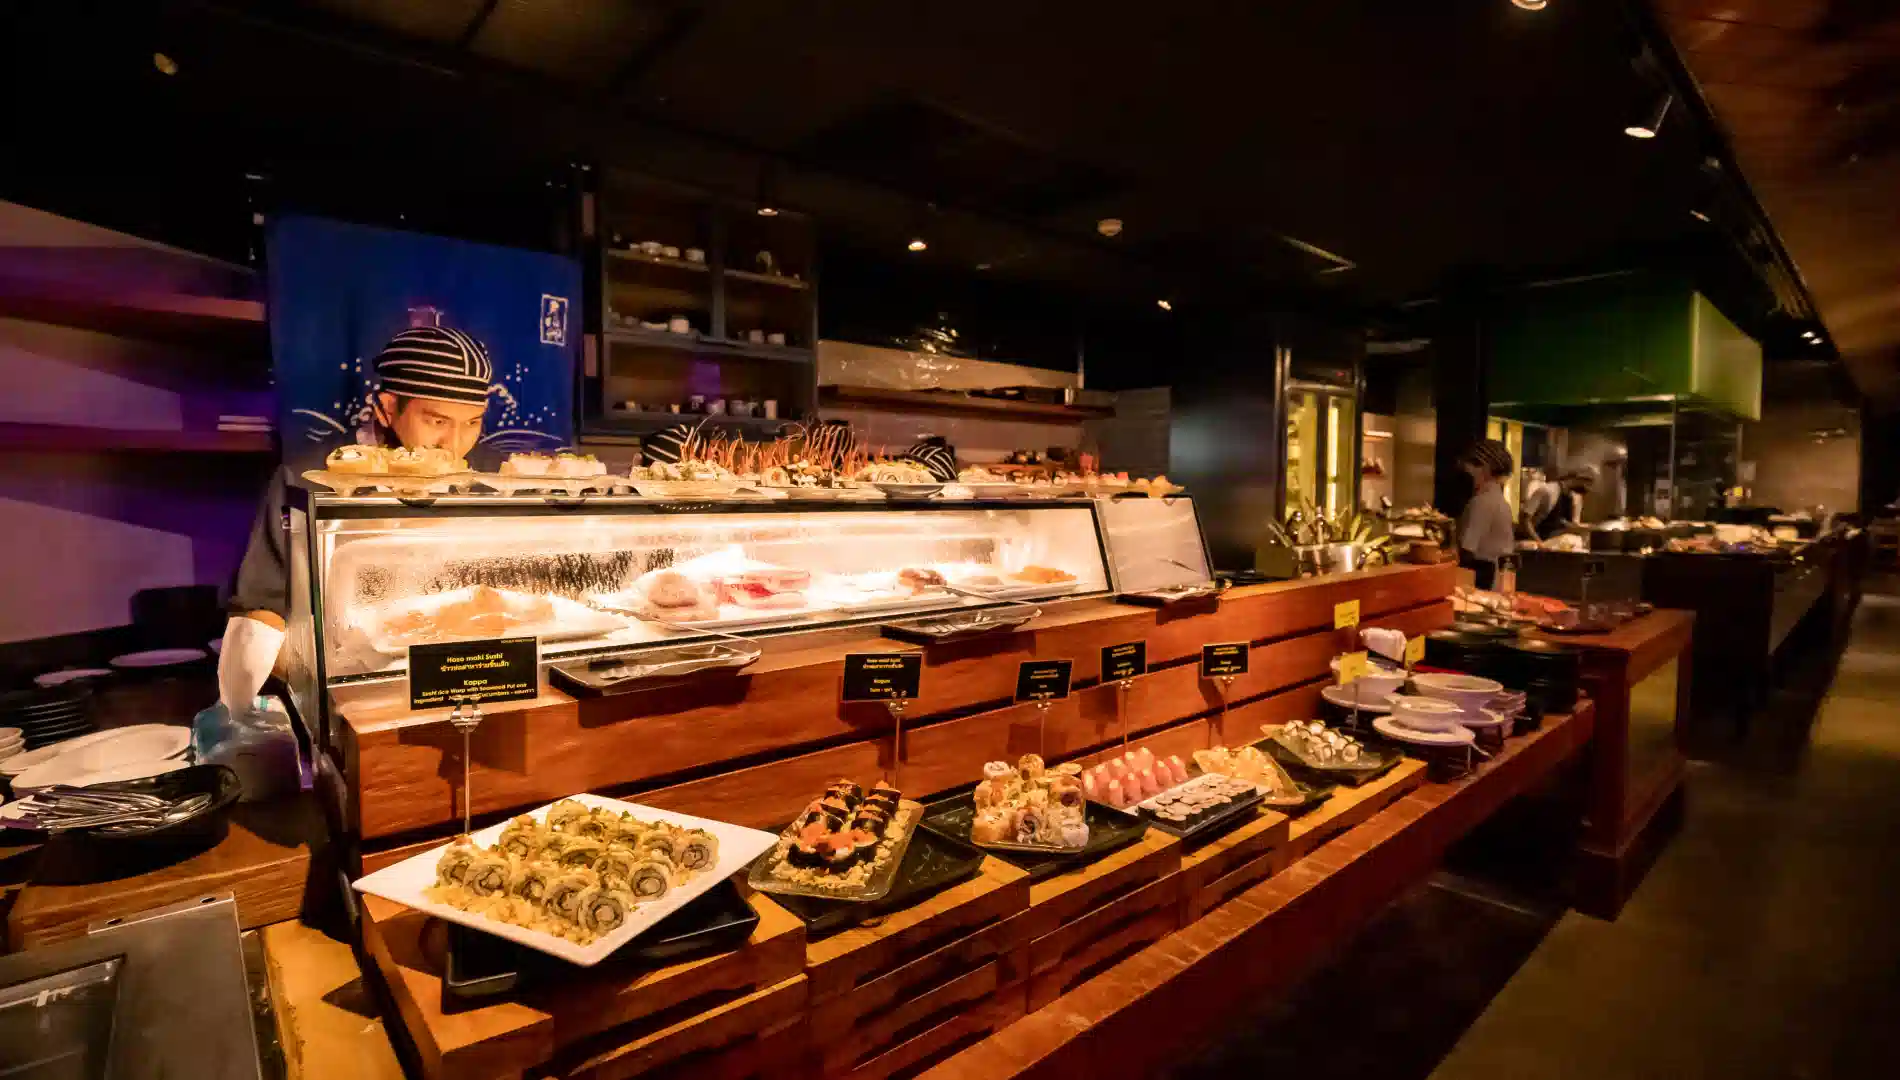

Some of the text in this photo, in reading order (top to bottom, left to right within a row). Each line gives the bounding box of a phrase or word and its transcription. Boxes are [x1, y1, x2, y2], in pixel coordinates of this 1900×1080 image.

[466, 654, 485, 662] maki
[485, 652, 504, 660] Sushi
[463, 679, 488, 687] Kappa
